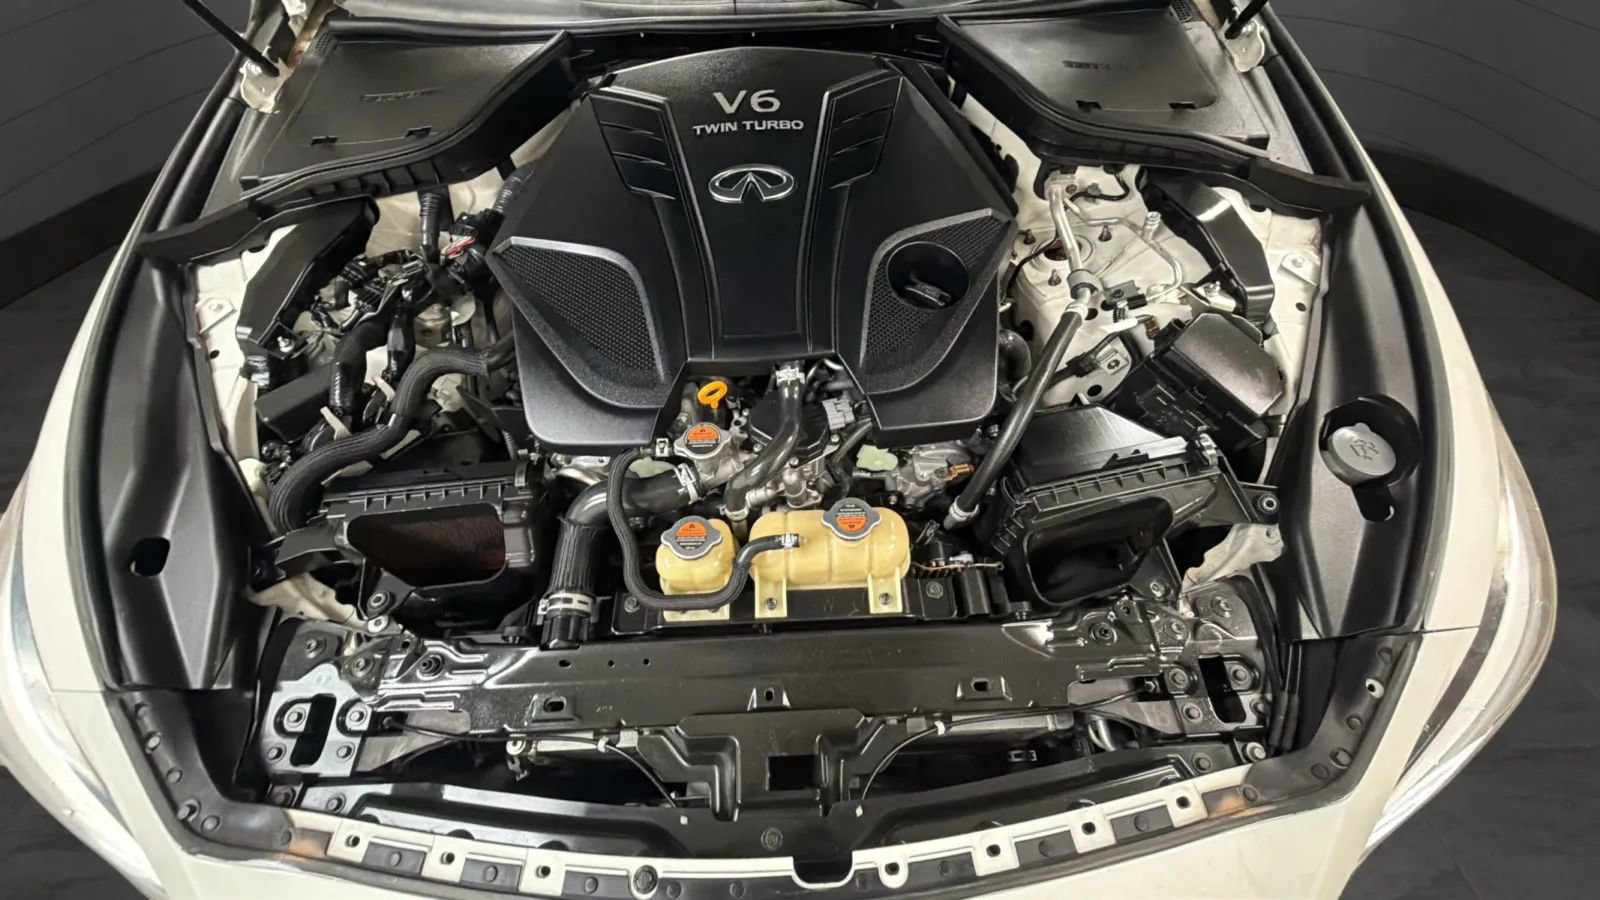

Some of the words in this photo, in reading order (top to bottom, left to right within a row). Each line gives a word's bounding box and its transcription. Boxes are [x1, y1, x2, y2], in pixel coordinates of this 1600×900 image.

[713, 89, 780, 114] V6
[692, 121, 738, 135] TWIN
[742, 119, 804, 130] TURBO
